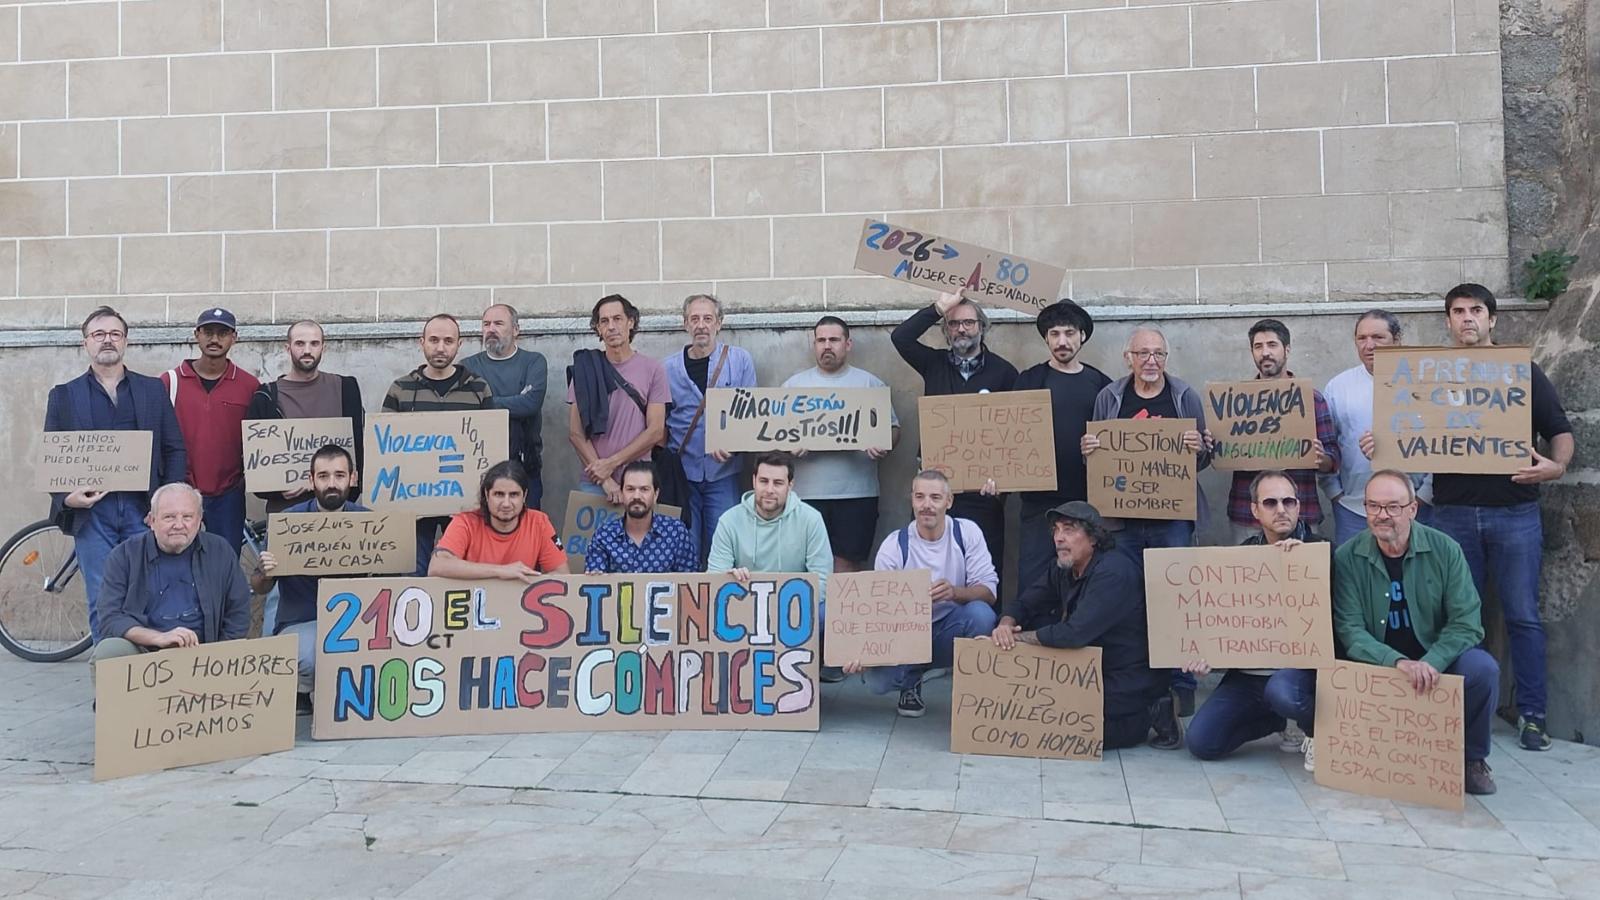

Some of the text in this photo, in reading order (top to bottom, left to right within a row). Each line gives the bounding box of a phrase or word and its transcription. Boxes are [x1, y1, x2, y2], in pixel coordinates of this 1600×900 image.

[865, 224, 1029, 286] 2026 80
[893, 259, 1047, 308] MUJERES ASESINADAS
[1391, 357, 1531, 385] APRENDER
[792, 393, 846, 414] ESTÁN
[1209, 382, 1305, 421] VIOLENCIA
[1391, 386, 1526, 413] A CUIDAR
[931, 404, 1043, 428] SI TIENES
[1447, 411, 1485, 430] DE
[43, 435, 71, 443] LOS
[247, 422, 280, 441] SER
[374, 424, 457, 455] VIOLENCIA
[950, 428, 1033, 446] HUEVOS
[942, 445, 1040, 462] PONTE A
[1397, 435, 1530, 459] VALIENTES
[44, 455, 90, 464] PUEDEN
[1112, 457, 1190, 480] TU MANERA
[371, 465, 464, 504] MACHISTA
[1103, 475, 1160, 494] DE SER
[1114, 498, 1184, 512] HOMBRE
[360, 515, 389, 536] TÚ
[284, 535, 397, 555] TAMBIÉN VIVES
[304, 554, 384, 568] EN CASA
[1165, 562, 1320, 586] CONTRA EL
[835, 578, 914, 599] YA ERA
[444, 587, 501, 631] EL
[520, 578, 815, 649] SILENCIO
[841, 601, 908, 616] HORA
[832, 620, 865, 635] QUE
[1184, 612, 1314, 636] HOMOFOBIA Y
[861, 638, 895, 656] AQUÍ
[1180, 636, 1322, 657] LA TRANSFOBIA
[126, 654, 296, 692] LOS HOMBRES
[334, 642, 815, 722] NOS HACE CÓMPLICES
[158, 679, 275, 715] TAMBIÉN
[1006, 682, 1056, 707] TUS
[957, 693, 1096, 733] PRIVILEGIOS
[1335, 695, 1438, 732] NUESTROS
[134, 713, 254, 749] LLORAMOS
[971, 725, 1103, 758] COMO HOMBRE
[1339, 721, 1458, 752] ES EL PRIMER
[1328, 735, 1380, 759] PARA
[1330, 759, 1416, 785] ESPACIOS
